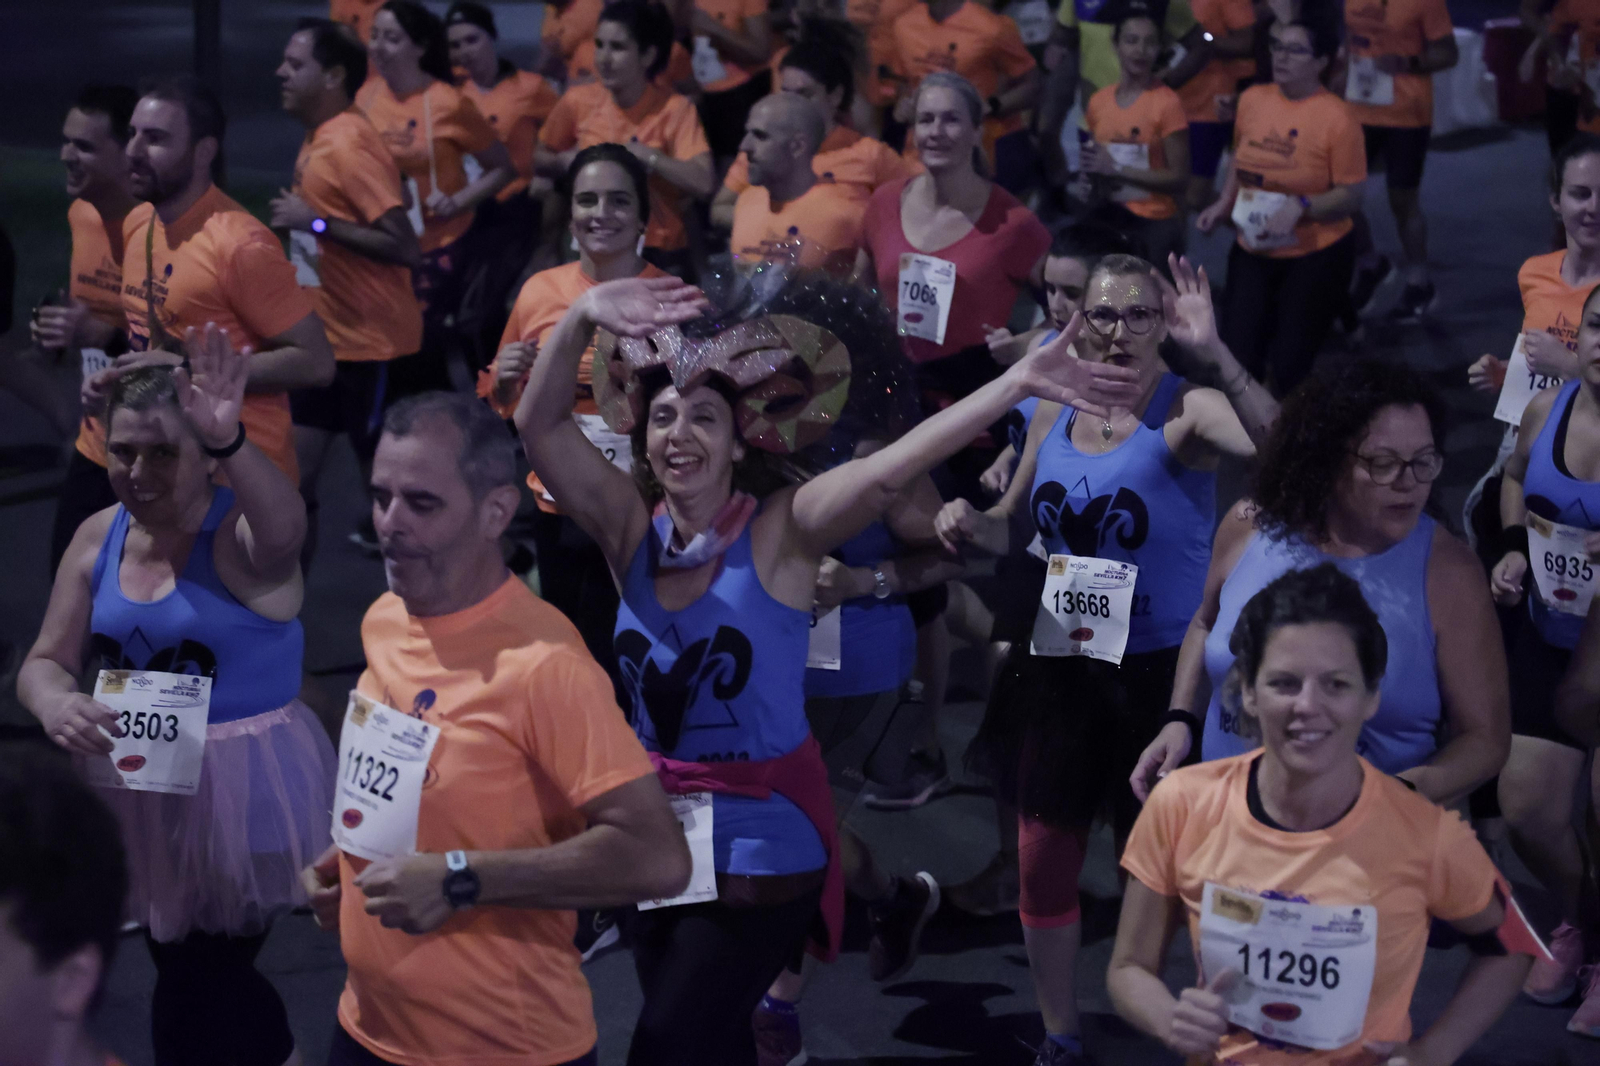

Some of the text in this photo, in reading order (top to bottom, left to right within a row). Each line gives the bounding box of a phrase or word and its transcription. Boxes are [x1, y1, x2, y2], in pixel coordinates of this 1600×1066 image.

[903, 281, 937, 305] 7068
[1544, 551, 1593, 581] 6935
[1053, 590, 1110, 618] 13668
[111, 710, 179, 742] 3503
[344, 746, 399, 802] 11322
[1238, 943, 1340, 990] 11296
